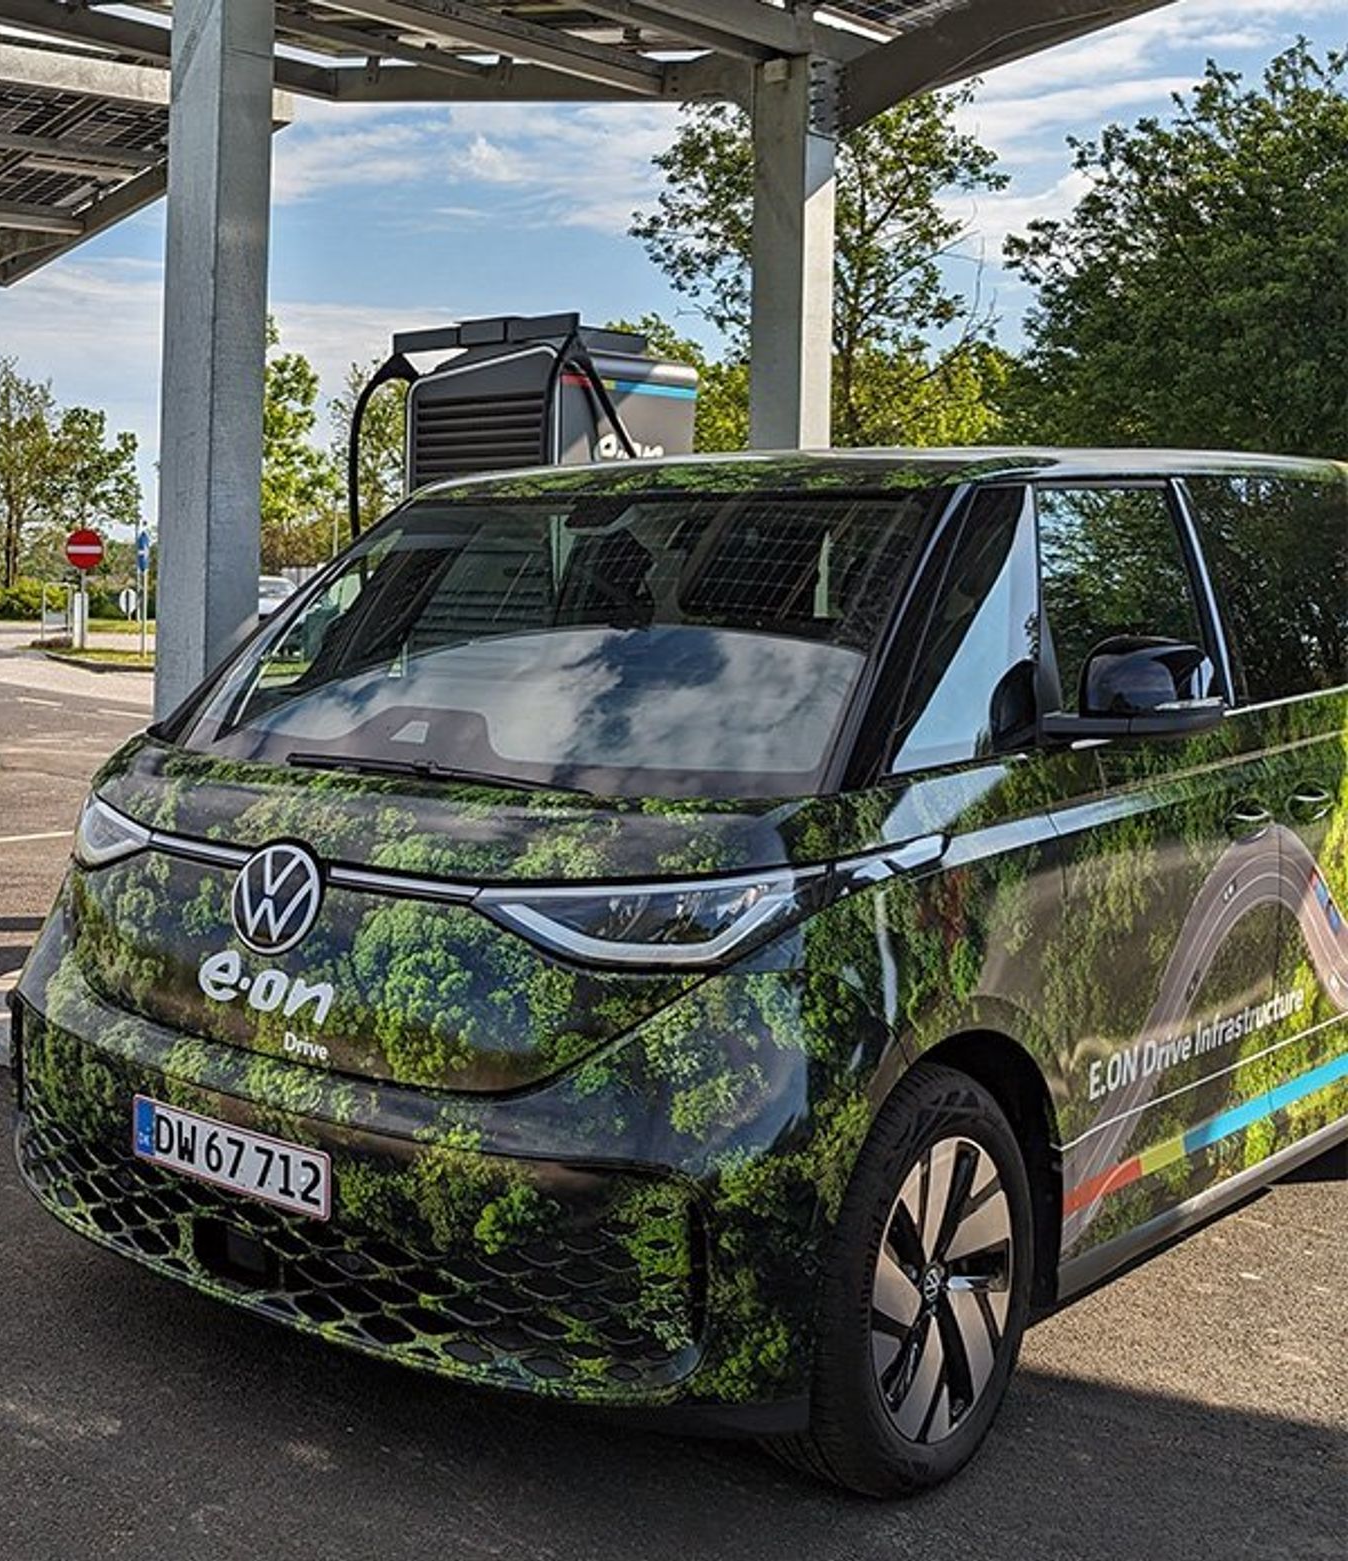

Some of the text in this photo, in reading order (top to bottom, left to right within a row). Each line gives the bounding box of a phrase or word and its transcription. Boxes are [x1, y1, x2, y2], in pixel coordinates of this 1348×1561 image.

[283, 1031, 329, 1060] Drive
[1089, 988, 1305, 1101] E.ON Drive Infrastructure
[155, 1115, 321, 1205] DW 67 712
